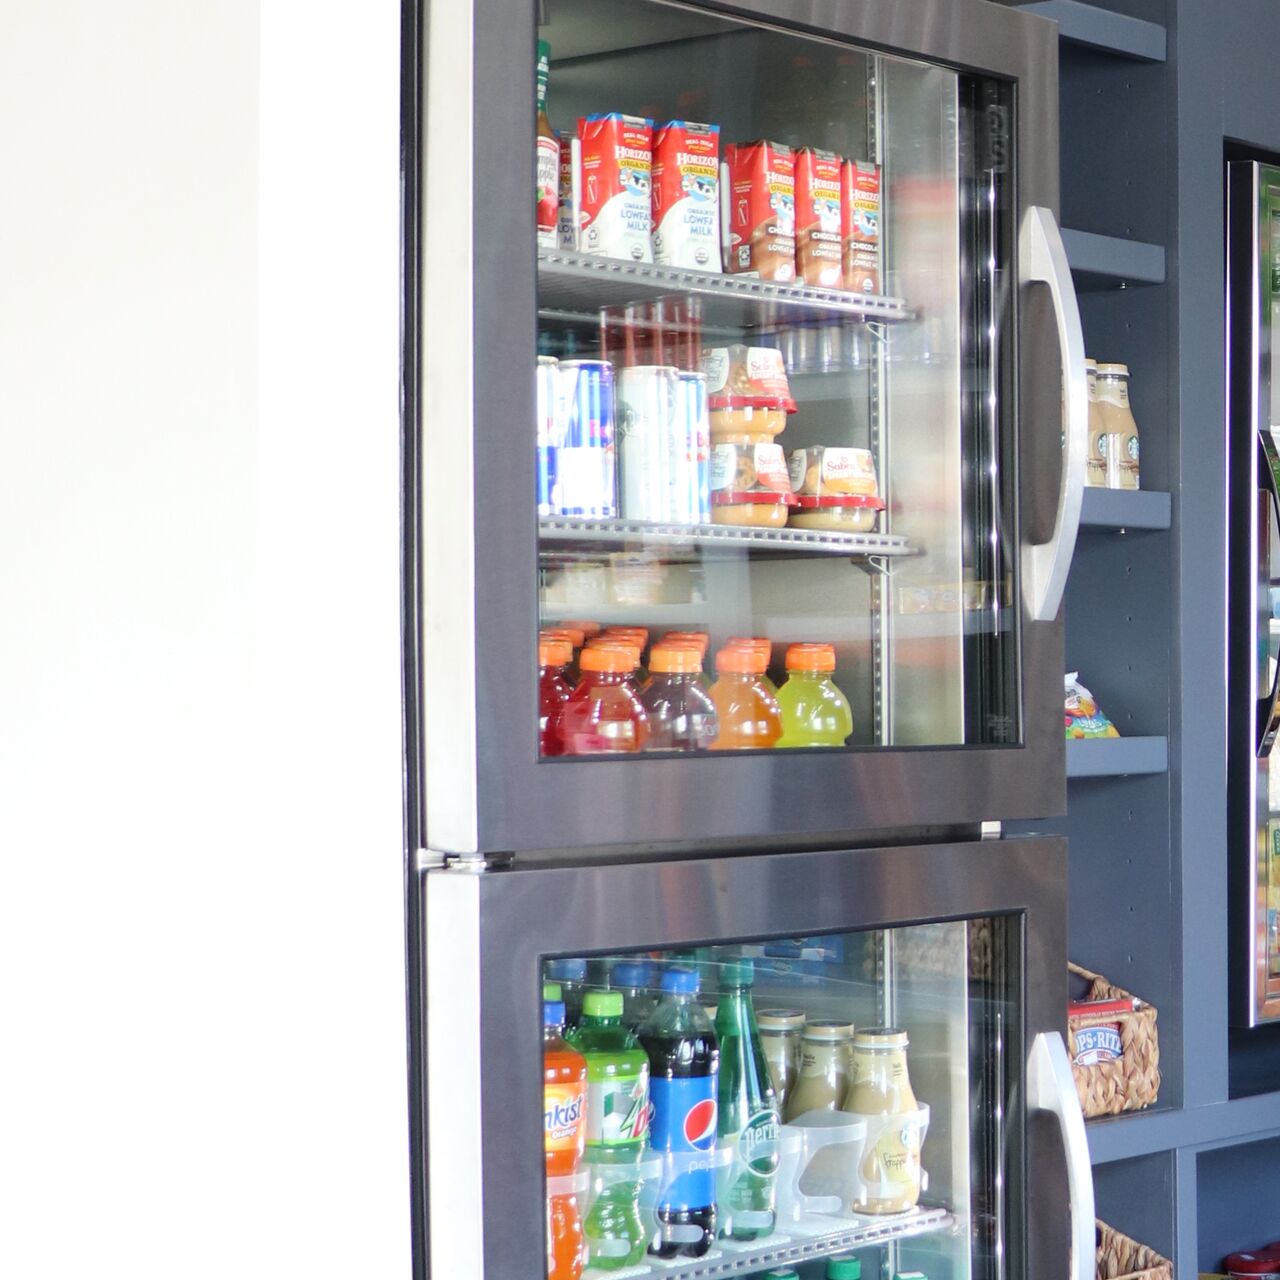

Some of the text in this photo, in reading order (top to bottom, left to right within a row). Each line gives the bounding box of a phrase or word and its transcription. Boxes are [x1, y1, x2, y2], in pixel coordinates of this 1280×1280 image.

[620, 210, 650, 221] LOWFA
[626, 222, 649, 232] MILK
[690, 226, 713, 236] MILK
[851, 241, 878, 252] CHOCOLA
